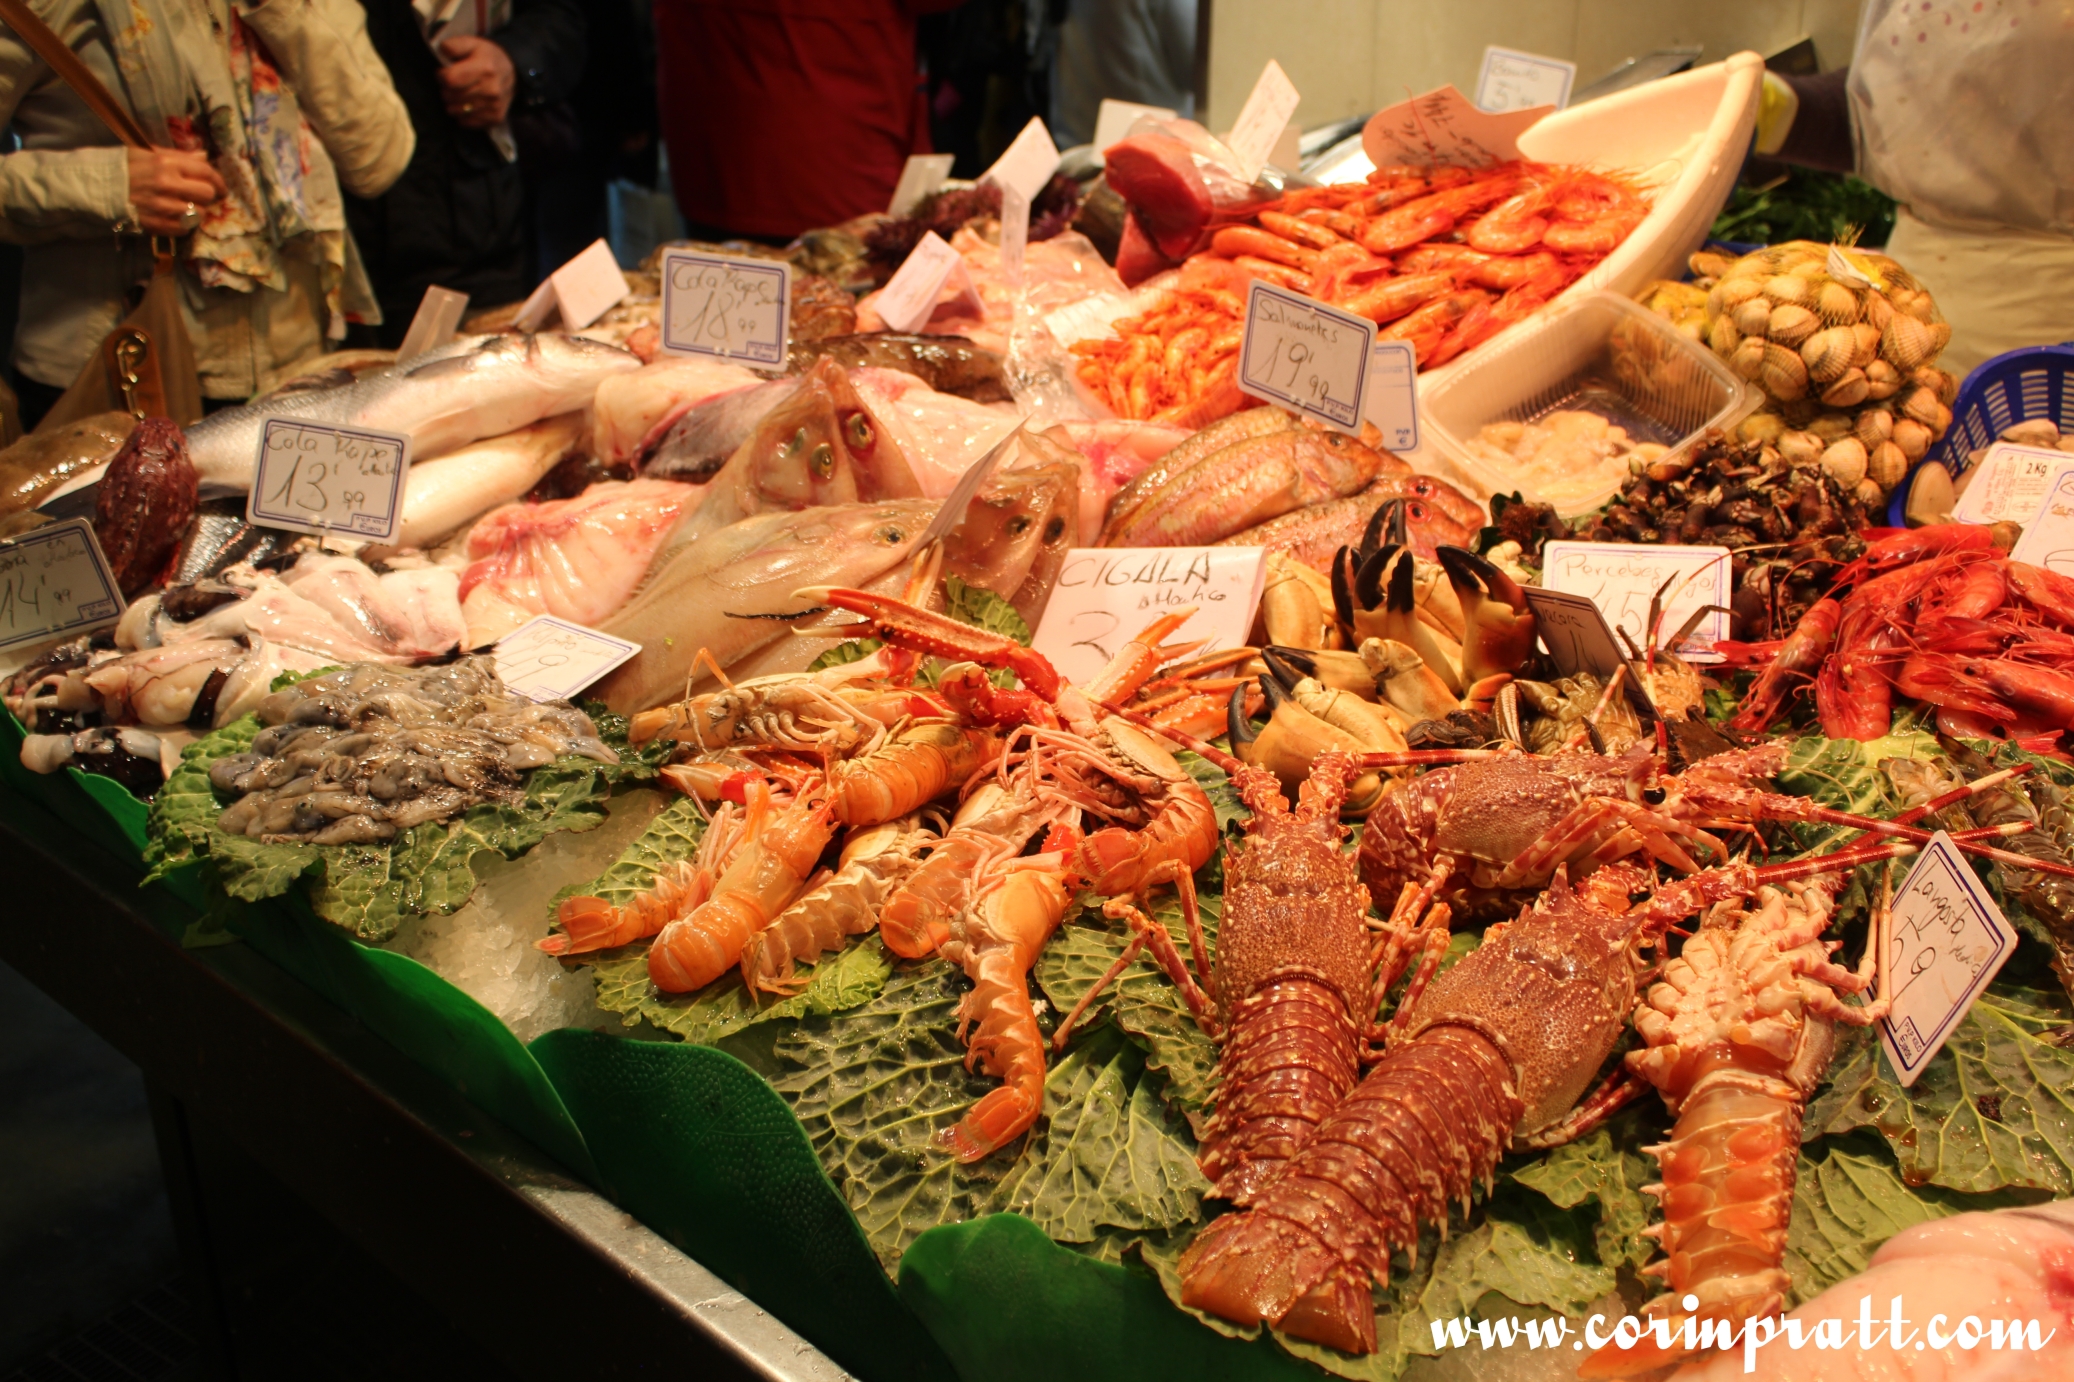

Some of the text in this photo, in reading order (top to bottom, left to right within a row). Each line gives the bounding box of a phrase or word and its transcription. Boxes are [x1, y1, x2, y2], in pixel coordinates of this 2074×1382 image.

[672, 263, 717, 291] Cola
[1255, 299, 1340, 344] Salmonetes
[266, 427, 318, 456] Cola
[2026, 462, 2048, 477] 2 Kg
[1058, 551, 1211, 588] CIGALA
[1556, 553, 1662, 578] Percebes
[1911, 858, 1972, 946] Langosta
